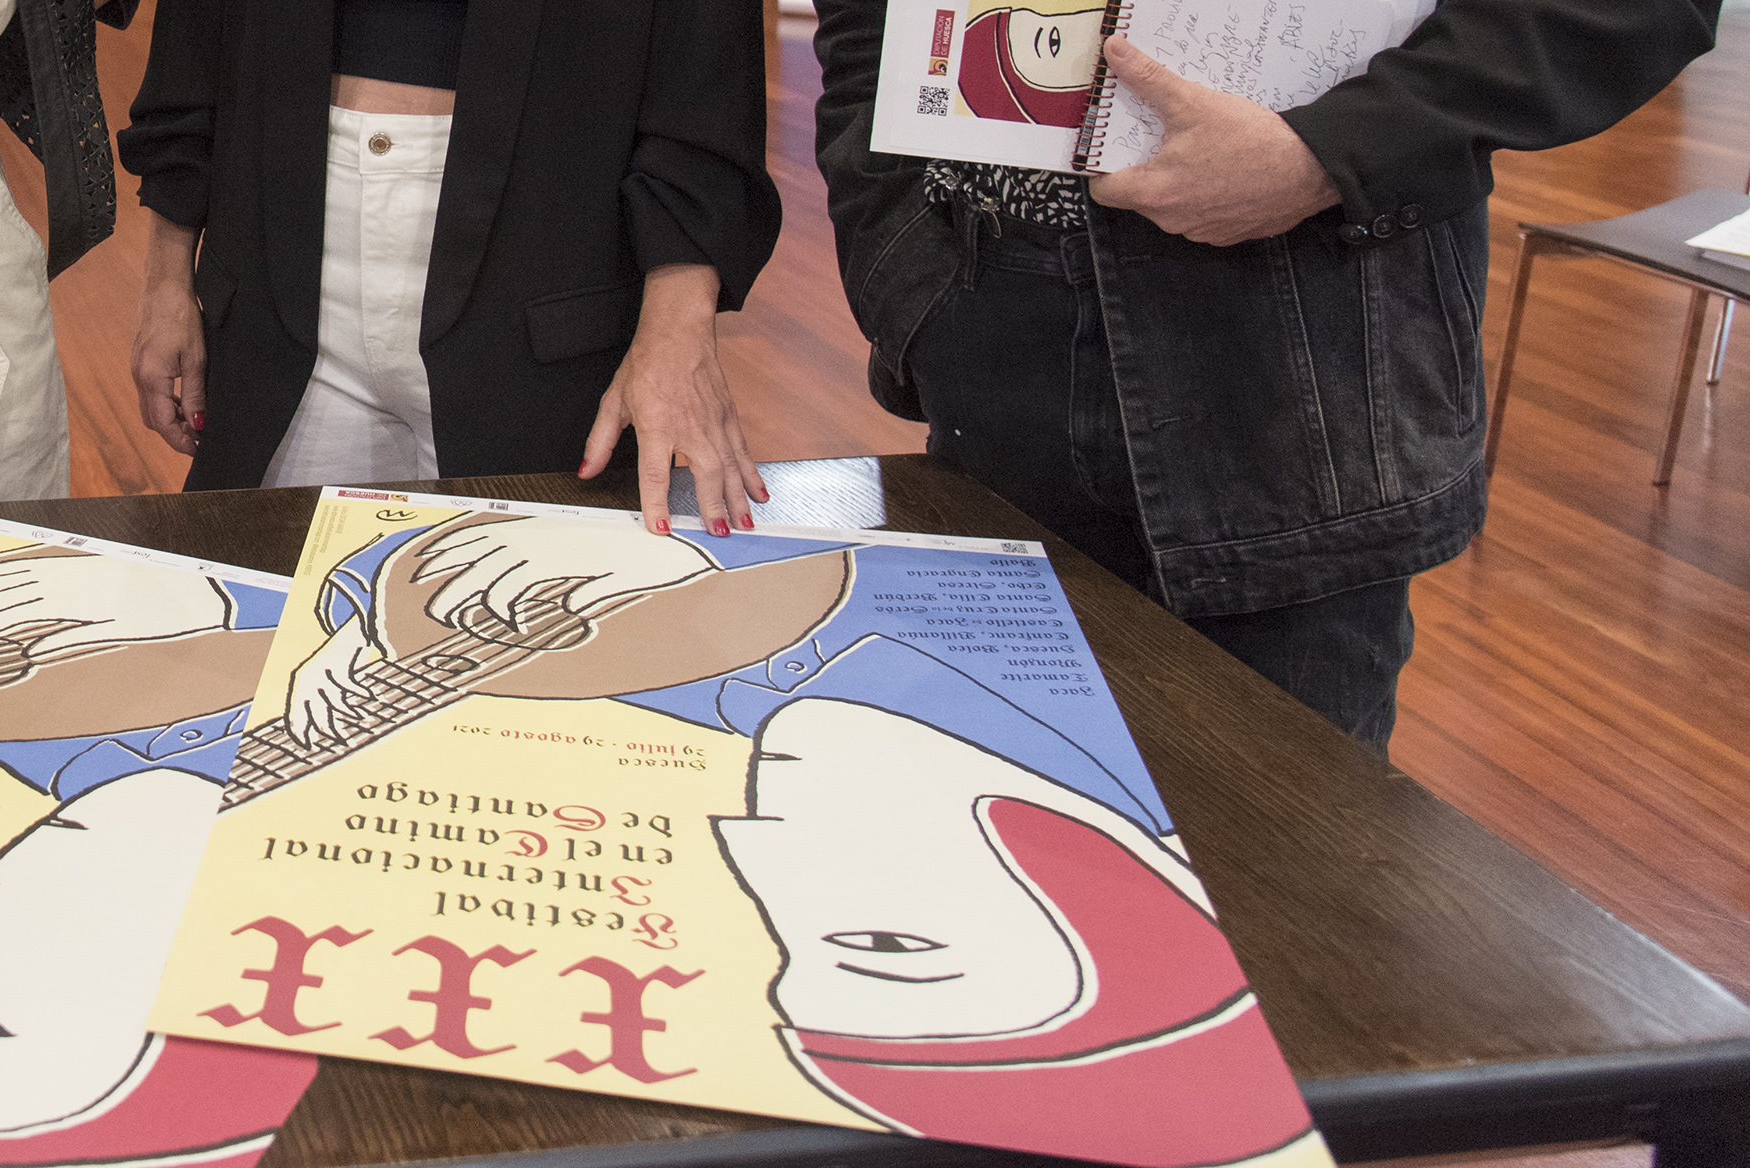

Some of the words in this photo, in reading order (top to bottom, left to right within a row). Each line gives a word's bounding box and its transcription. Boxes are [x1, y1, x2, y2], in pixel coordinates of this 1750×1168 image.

[934, 14, 945, 55] DIPUTACIÓN
[942, 17, 952, 44] HUESCA
[940, 45, 947, 56] DE
[990, 559, 1037, 567] Bailo
[907, 570, 982, 578] Engracia
[987, 570, 1041, 578] Santa
[938, 582, 996, 590] Siresa
[996, 594, 1052, 602] Santa
[956, 606, 998, 615] Cruz
[1002, 606, 1058, 615] Santa
[926, 618, 968, 627] Jaca
[986, 619, 1064, 628] Castiello
[948, 644, 1000, 654] Bolea
[1004, 644, 1075, 654] Huesca,
[1008, 658, 1082, 668] Monzón
[1000, 672, 1088, 682] Tamarite
[1050, 686, 1096, 696] Jaca
[452, 724, 492, 736] 2021
[500, 730, 576, 744] agosto
[582, 736, 605, 748] 29
[626, 742, 675, 756] julio
[683, 745, 705, 757] 29
[618, 757, 707, 772] Huesca
[356, 781, 606, 832] Santiago
[621, 812, 672, 838] de
[345, 814, 548, 858] Camino
[564, 838, 602, 862] el
[619, 843, 673, 865] en
[260, 837, 652, 906] Internacional
[430, 891, 678, 950] Festival
[196, 915, 707, 1084] XXX
